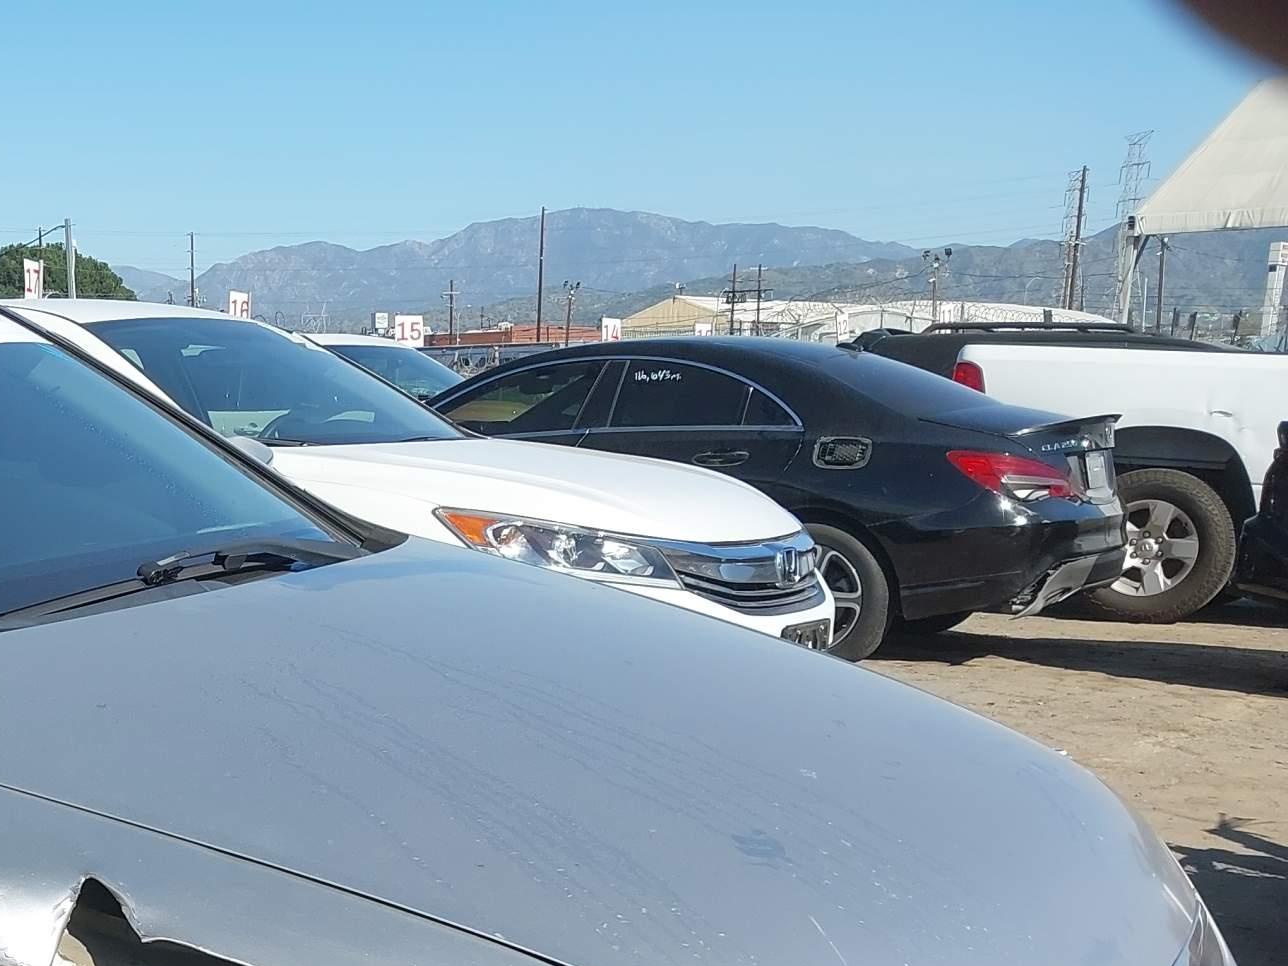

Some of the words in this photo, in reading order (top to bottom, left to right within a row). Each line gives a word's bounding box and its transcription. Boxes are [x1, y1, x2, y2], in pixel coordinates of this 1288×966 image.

[25, 268, 41, 295] 17
[396, 321, 422, 341] 15
[603, 323, 620, 341] 14
